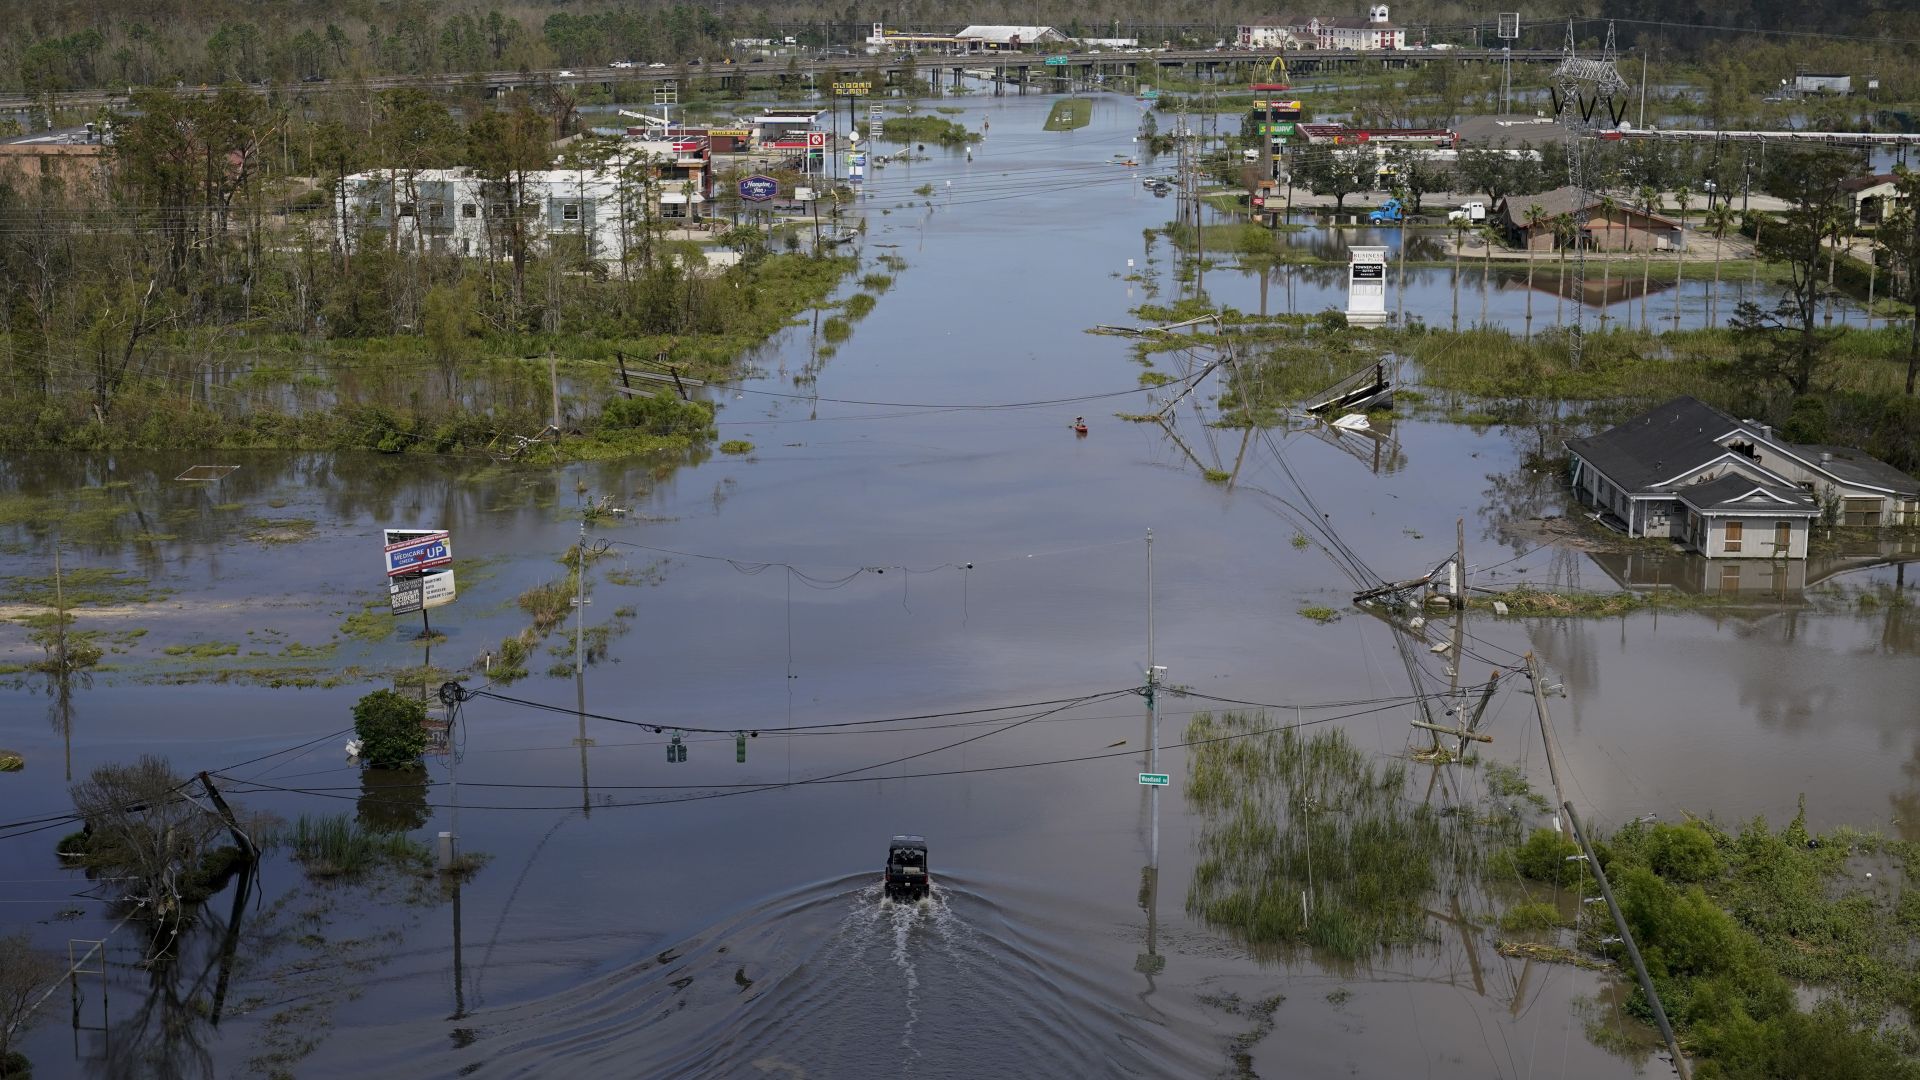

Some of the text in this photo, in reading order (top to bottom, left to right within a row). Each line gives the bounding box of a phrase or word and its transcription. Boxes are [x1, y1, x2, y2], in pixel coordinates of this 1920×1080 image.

[1260, 125, 1293, 133] SBWAY
[743, 180, 773, 189] Hampton
[394, 546, 443, 561] MEDICARE UP
